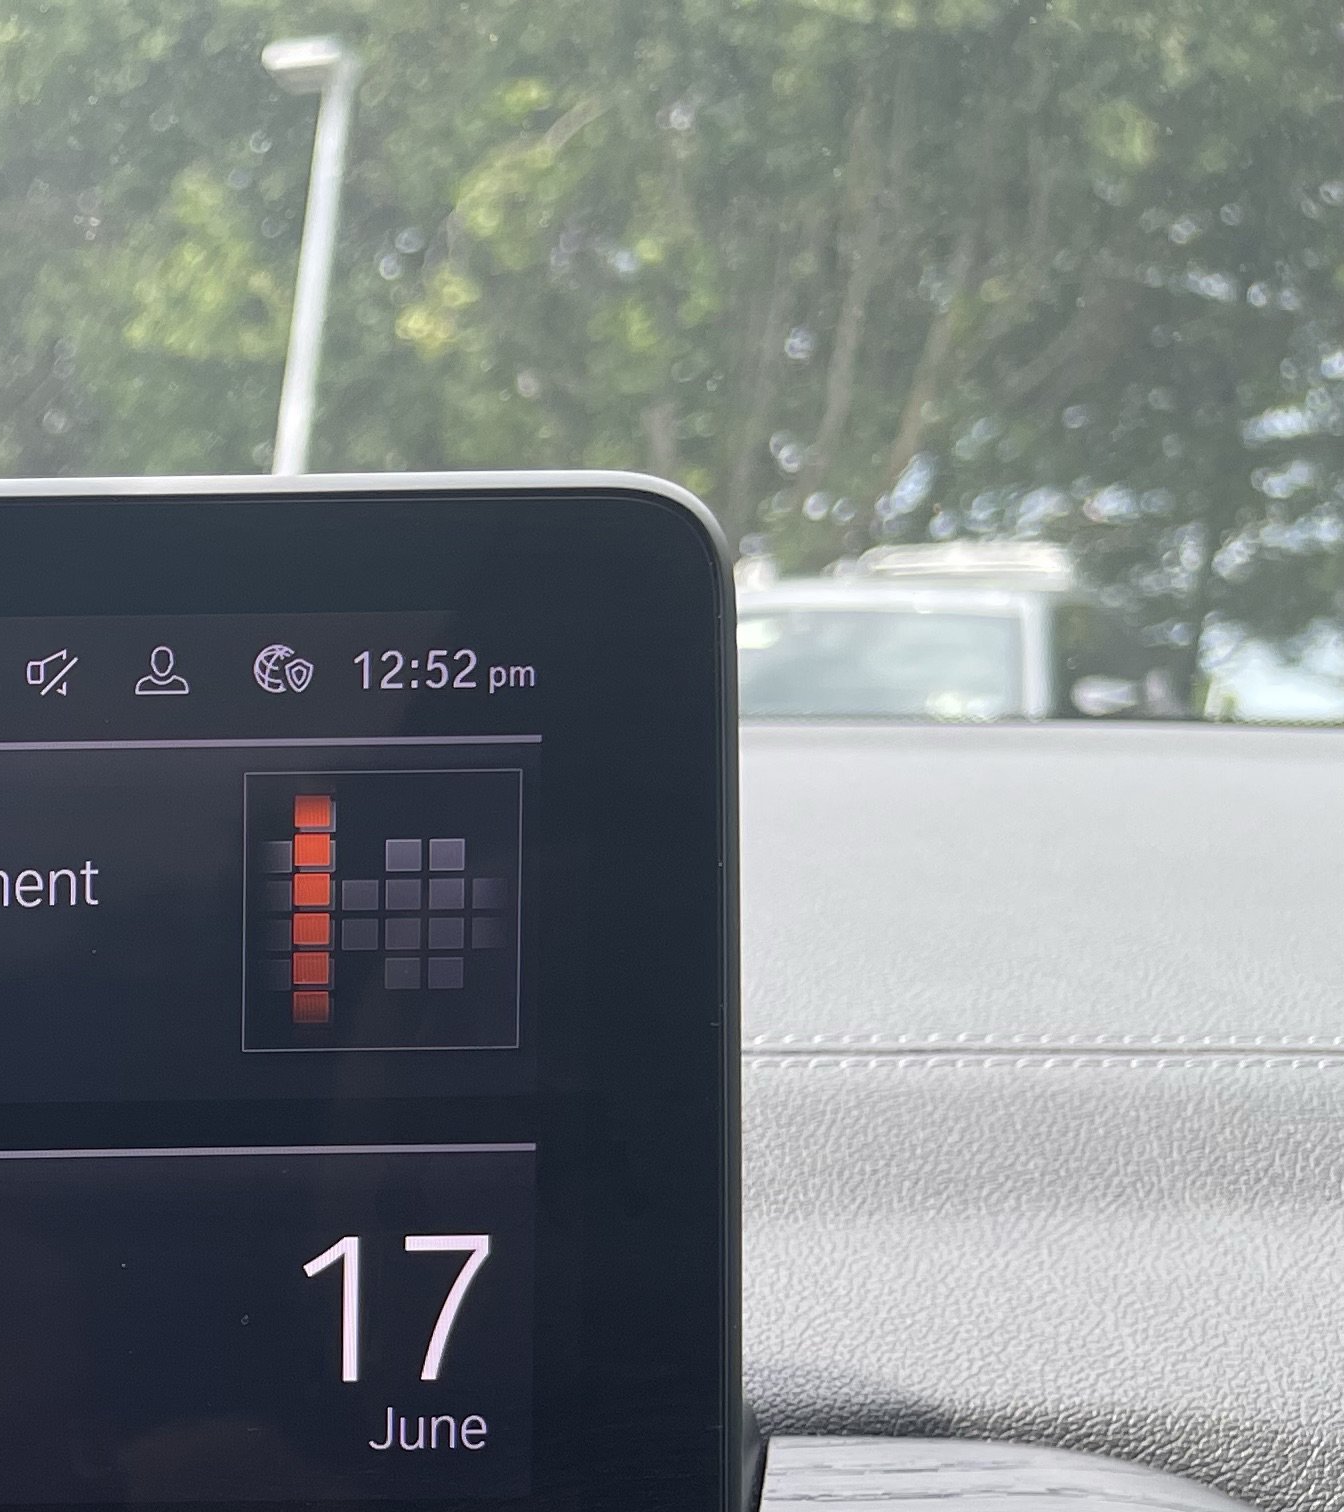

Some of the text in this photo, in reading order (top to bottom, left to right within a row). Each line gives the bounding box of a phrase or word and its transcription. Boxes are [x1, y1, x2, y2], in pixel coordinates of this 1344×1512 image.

[353, 649, 535, 694] 12:52 pm
[303, 1234, 490, 1382] 17
[368, 1406, 487, 1451] June
